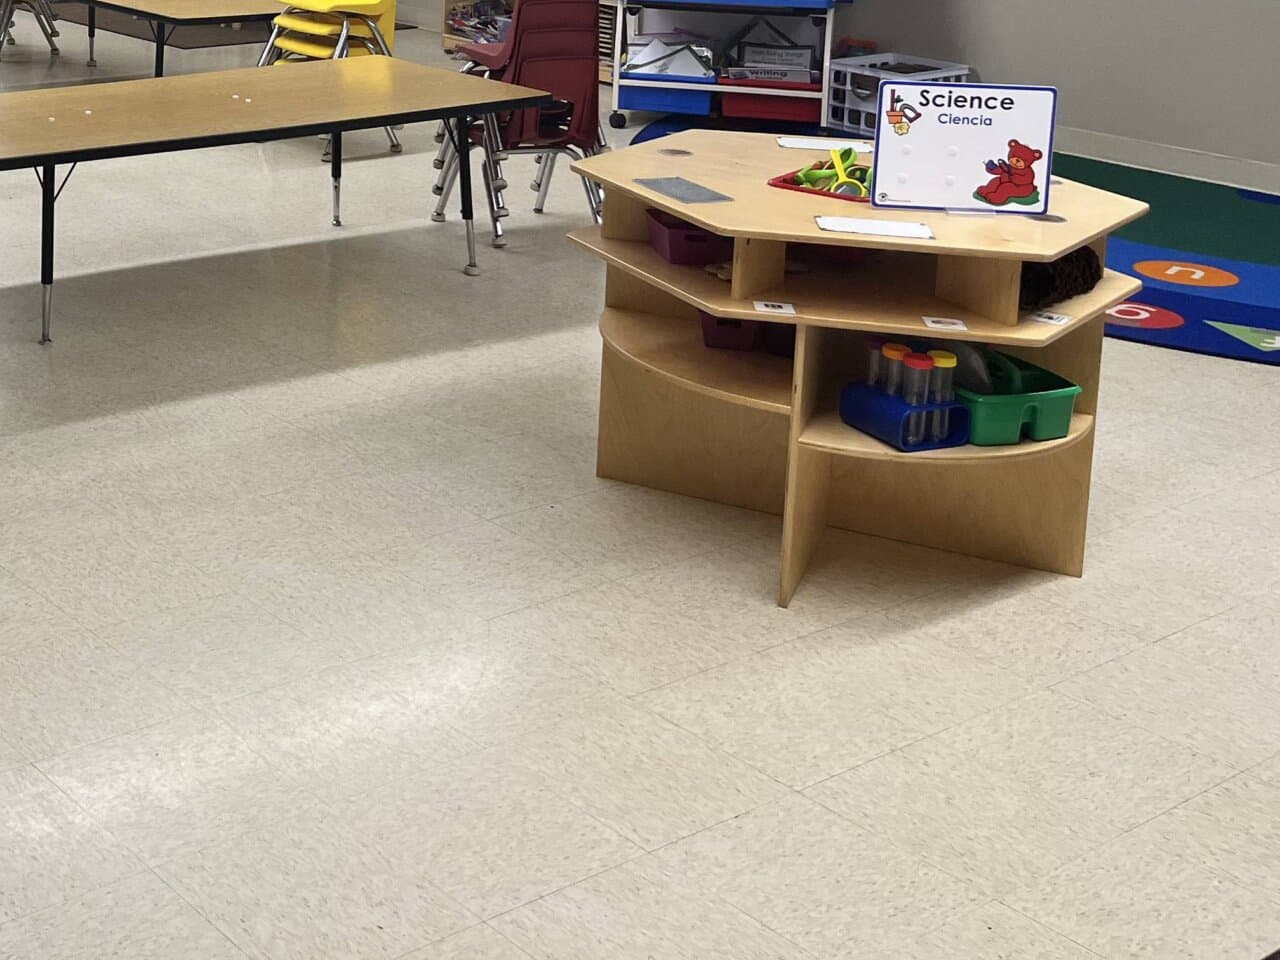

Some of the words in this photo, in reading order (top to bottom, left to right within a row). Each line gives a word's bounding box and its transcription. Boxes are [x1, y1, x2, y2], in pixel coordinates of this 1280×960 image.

[749, 68, 788, 78] Writing
[919, 89, 1015, 110] Science
[937, 113, 992, 126] Ciencia
